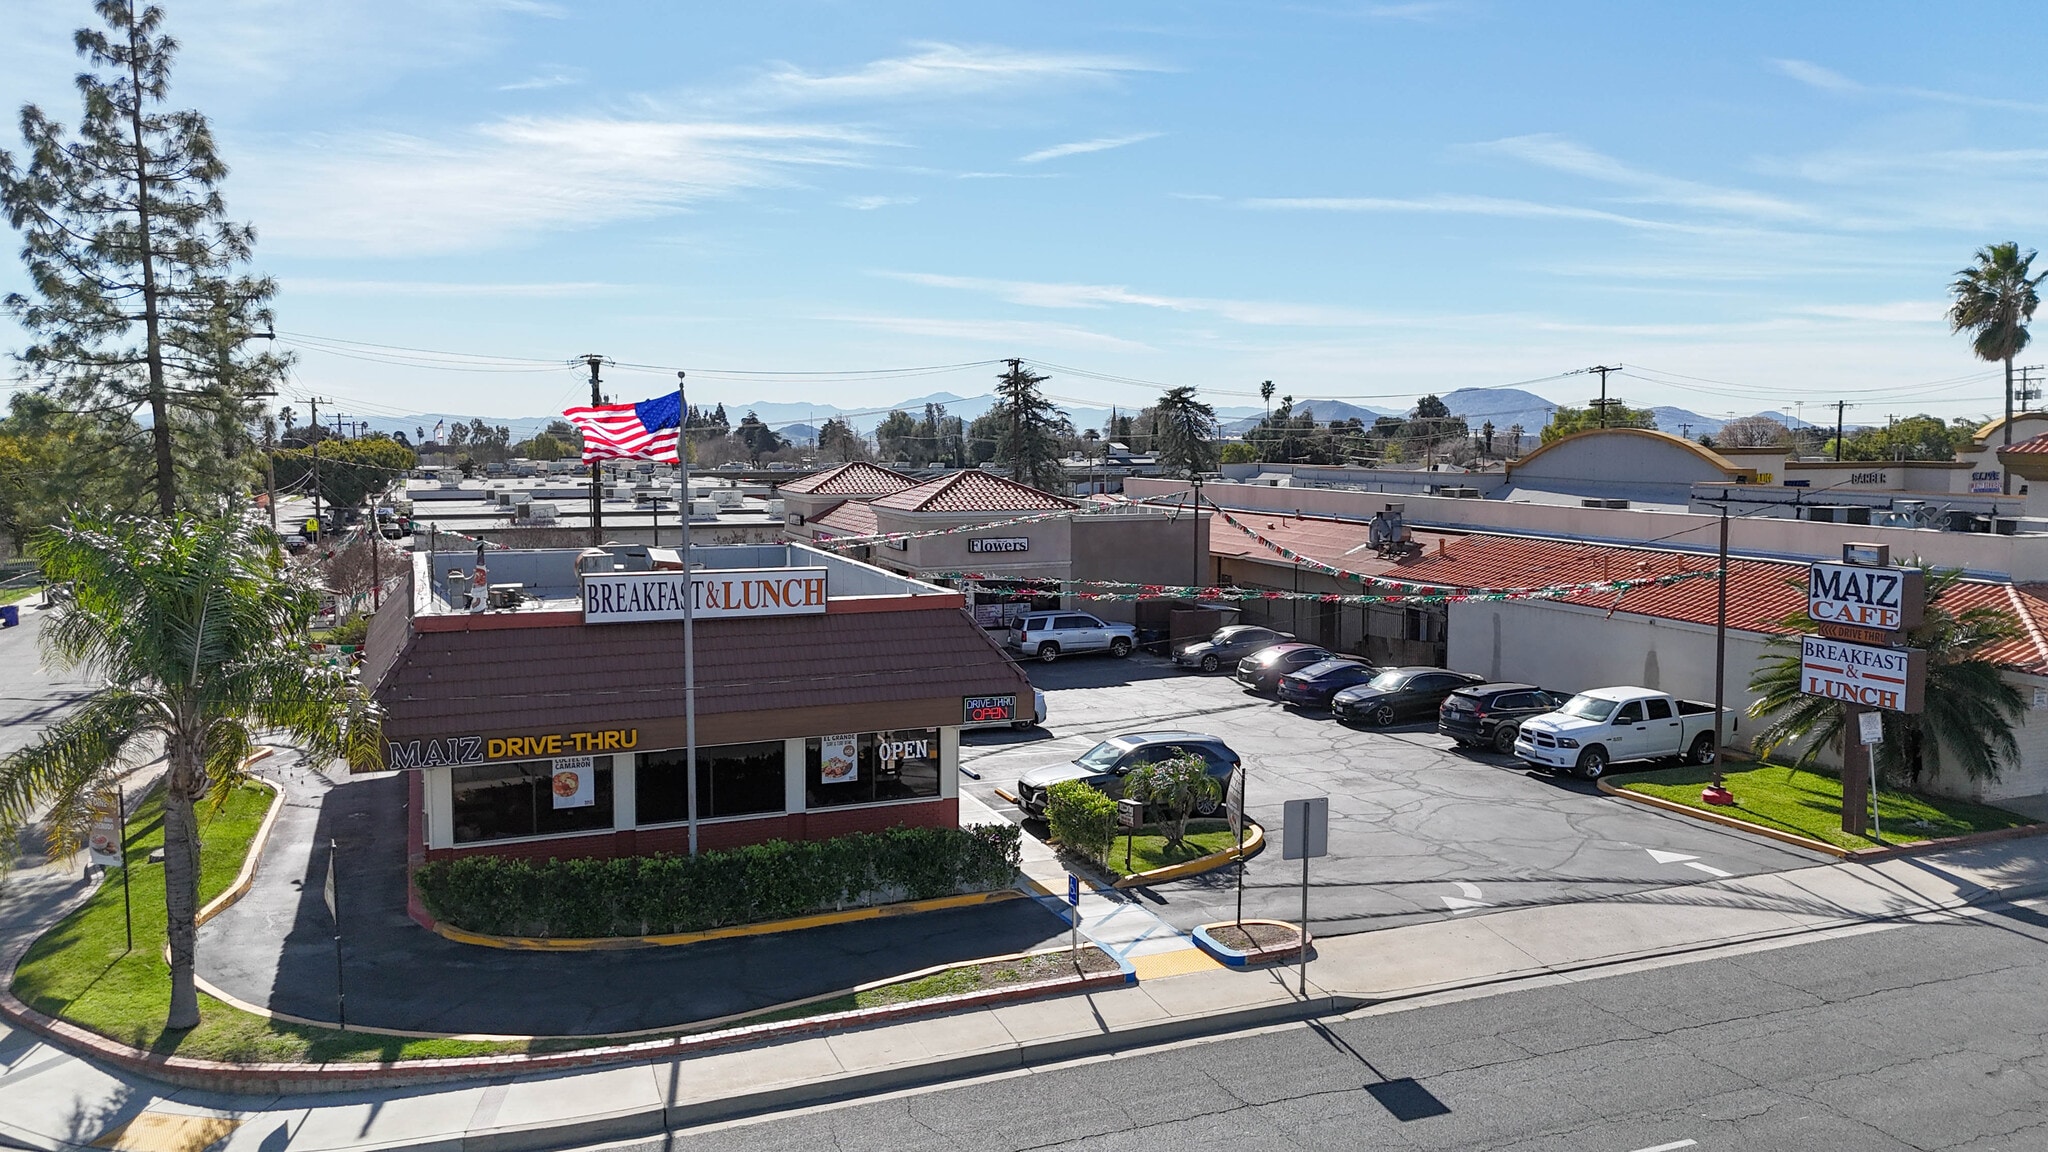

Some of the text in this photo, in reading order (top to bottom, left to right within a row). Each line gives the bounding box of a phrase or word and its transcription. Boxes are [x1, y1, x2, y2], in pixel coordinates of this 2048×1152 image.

[971, 539, 1026, 552] Flowers
[1812, 568, 1899, 608] MAIZ
[1812, 600, 1900, 628] CAFE
[1839, 627, 1863, 640] DRIVE
[1804, 642, 1908, 672] BREAKFAST
[1845, 664, 1859, 679] &
[1808, 677, 1899, 710] LUNCH
[972, 706, 1008, 720] OPEN
[388, 729, 638, 770] MAIZ DRIVE-THRU
[879, 739, 928, 761] OPEN
